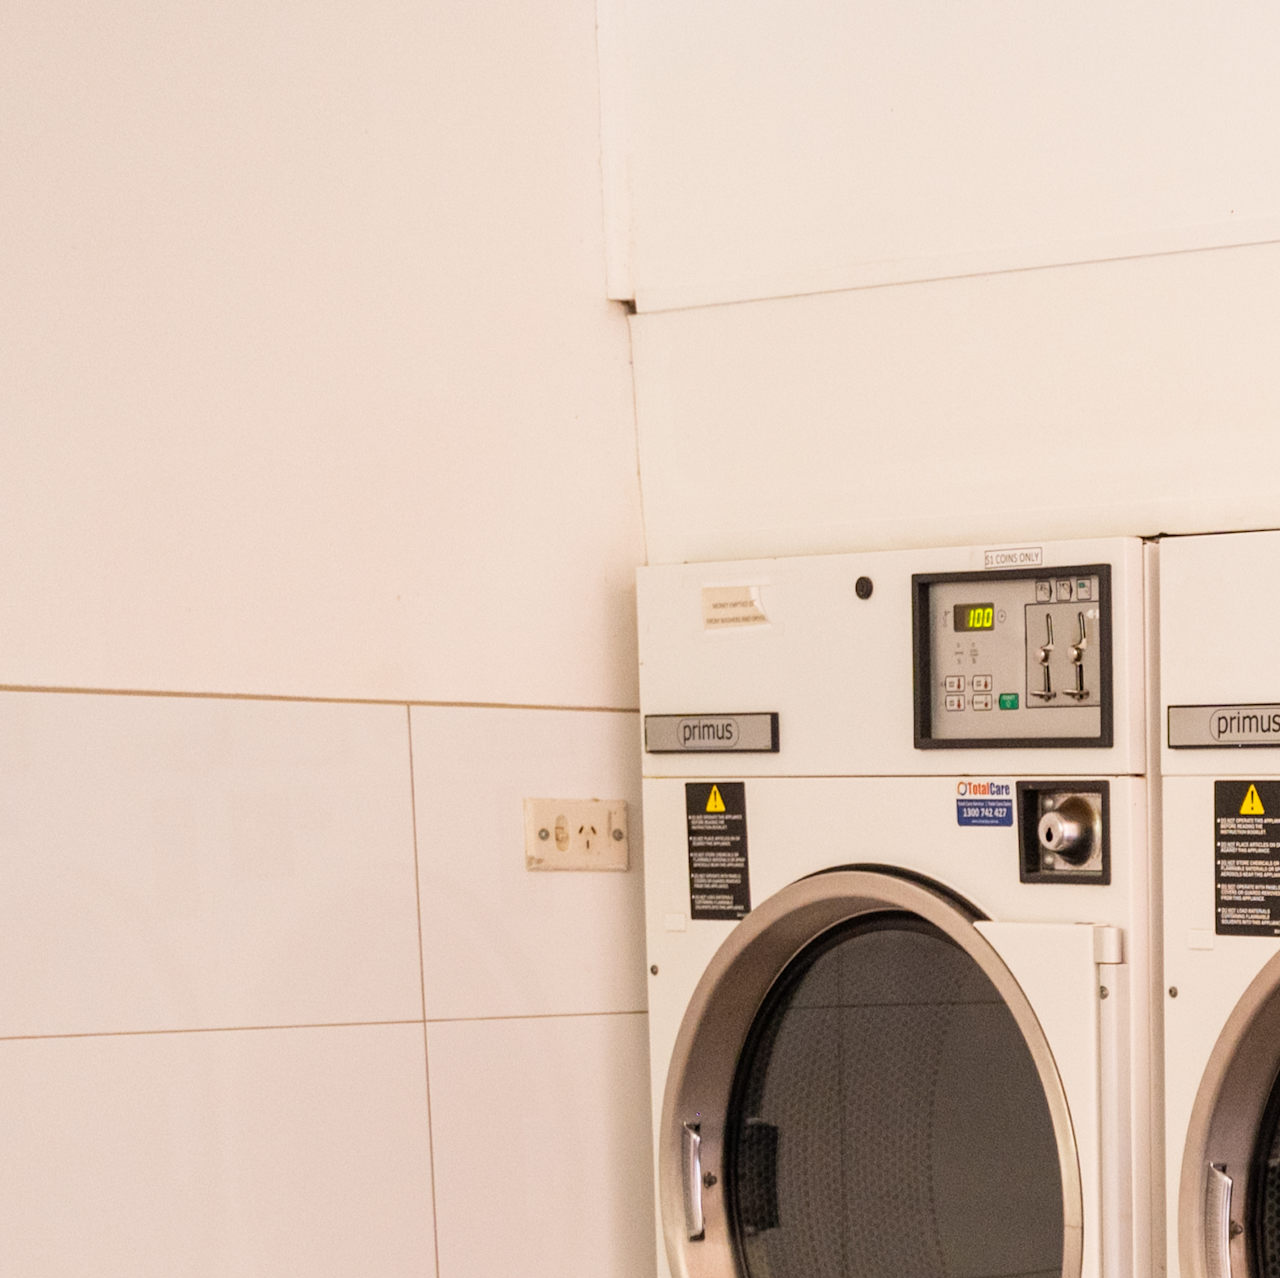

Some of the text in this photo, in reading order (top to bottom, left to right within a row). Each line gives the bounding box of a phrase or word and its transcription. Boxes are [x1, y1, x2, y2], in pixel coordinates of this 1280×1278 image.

[995, 553, 1017, 564] COINS
[1020, 552, 1039, 562] ONLY
[969, 608, 992, 628] 100
[683, 720, 733, 744] primus
[968, 782, 1010, 795] TotalCare
